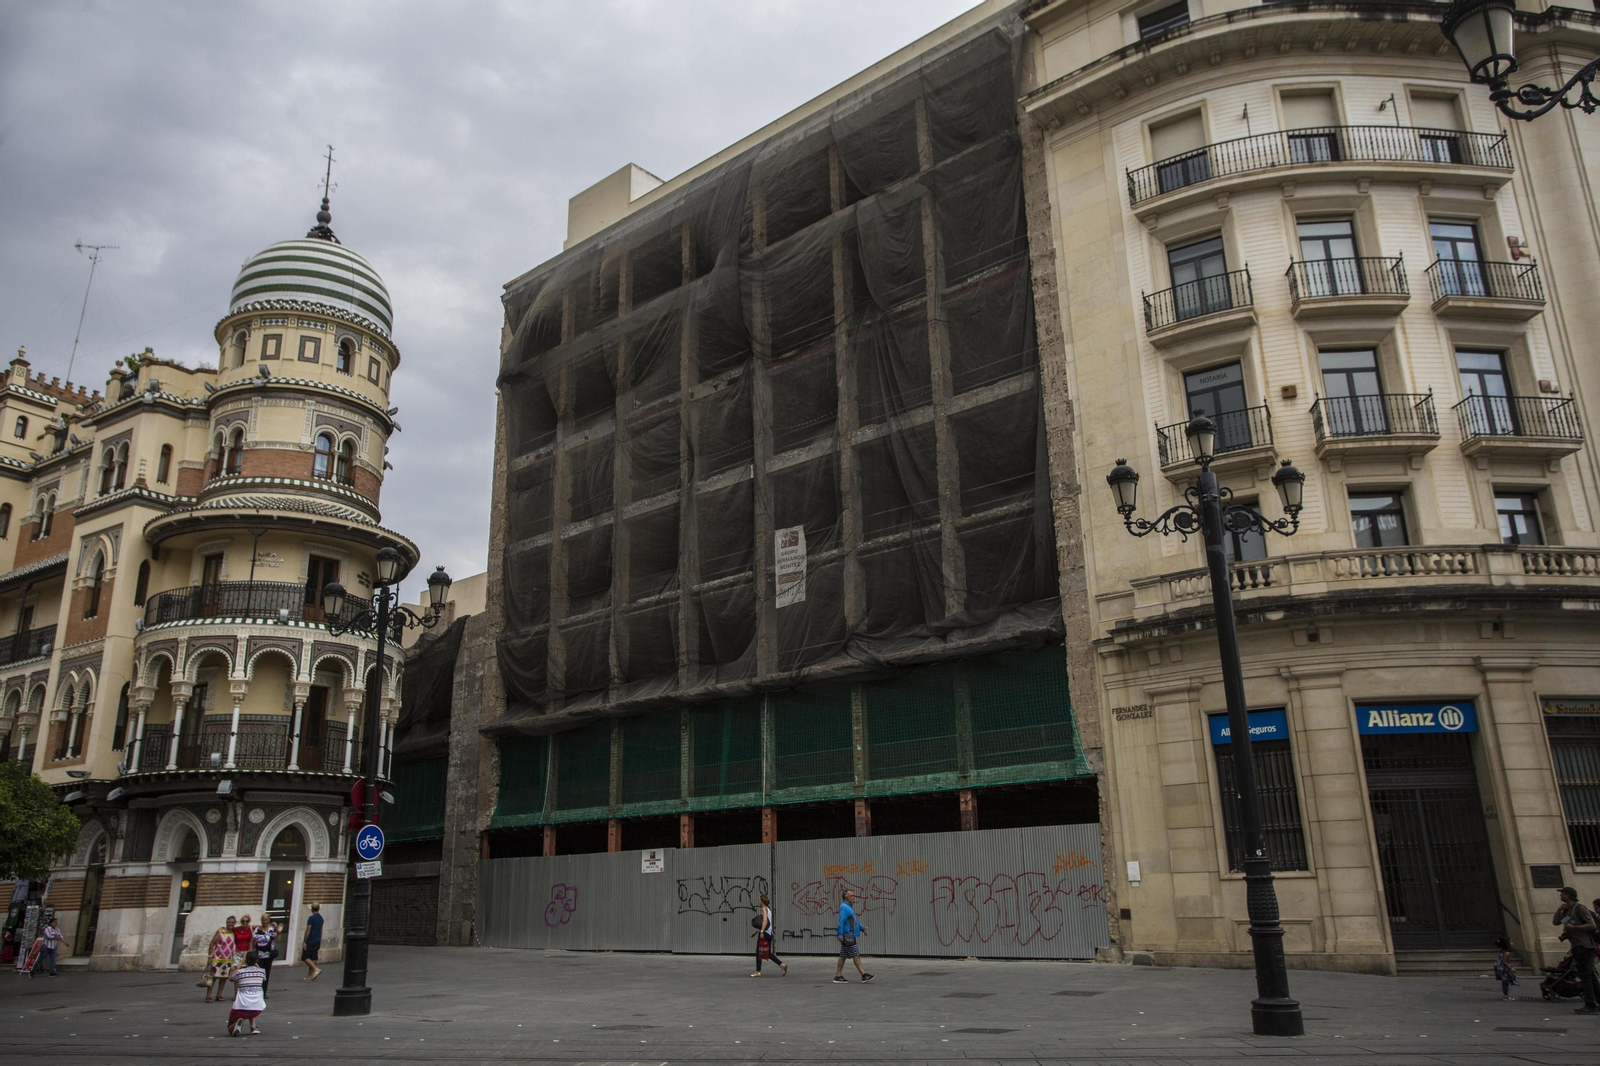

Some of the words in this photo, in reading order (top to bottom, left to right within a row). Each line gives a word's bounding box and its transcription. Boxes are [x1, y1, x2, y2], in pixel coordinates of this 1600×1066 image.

[781, 549, 798, 557] GRUPO
[777, 555, 805, 564] HERMANOS
[1112, 704, 1148, 715] FERNANDEZ
[1116, 711, 1153, 721] GONZALEZ
[1368, 709, 1435, 727] Allianz
